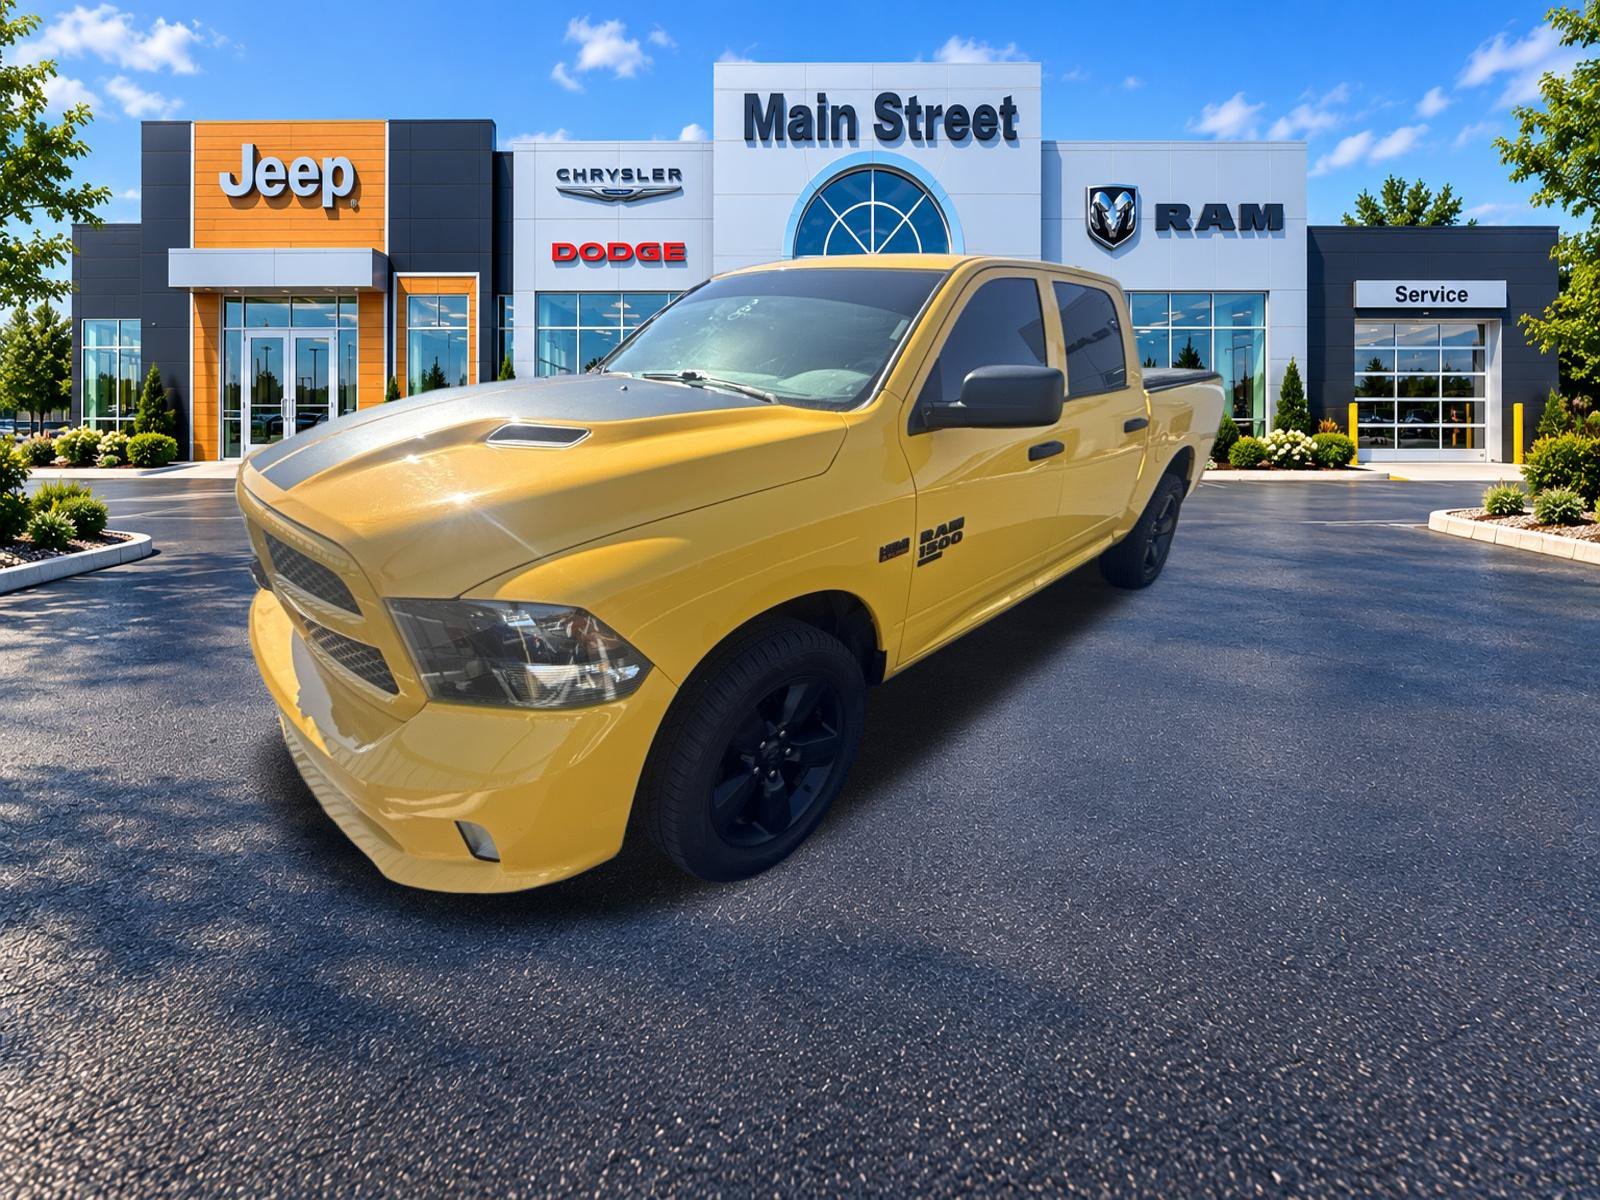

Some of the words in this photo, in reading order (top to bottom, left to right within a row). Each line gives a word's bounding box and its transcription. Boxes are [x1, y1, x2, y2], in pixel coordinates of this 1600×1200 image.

[744, 93, 856, 140] Main
[873, 91, 1017, 141] Street
[556, 168, 682, 181] CHRYSLER
[1155, 203, 1284, 231] RAM
[551, 242, 686, 261] DODGE
[1395, 285, 1469, 303] Service
[919, 530, 964, 558] 1500
